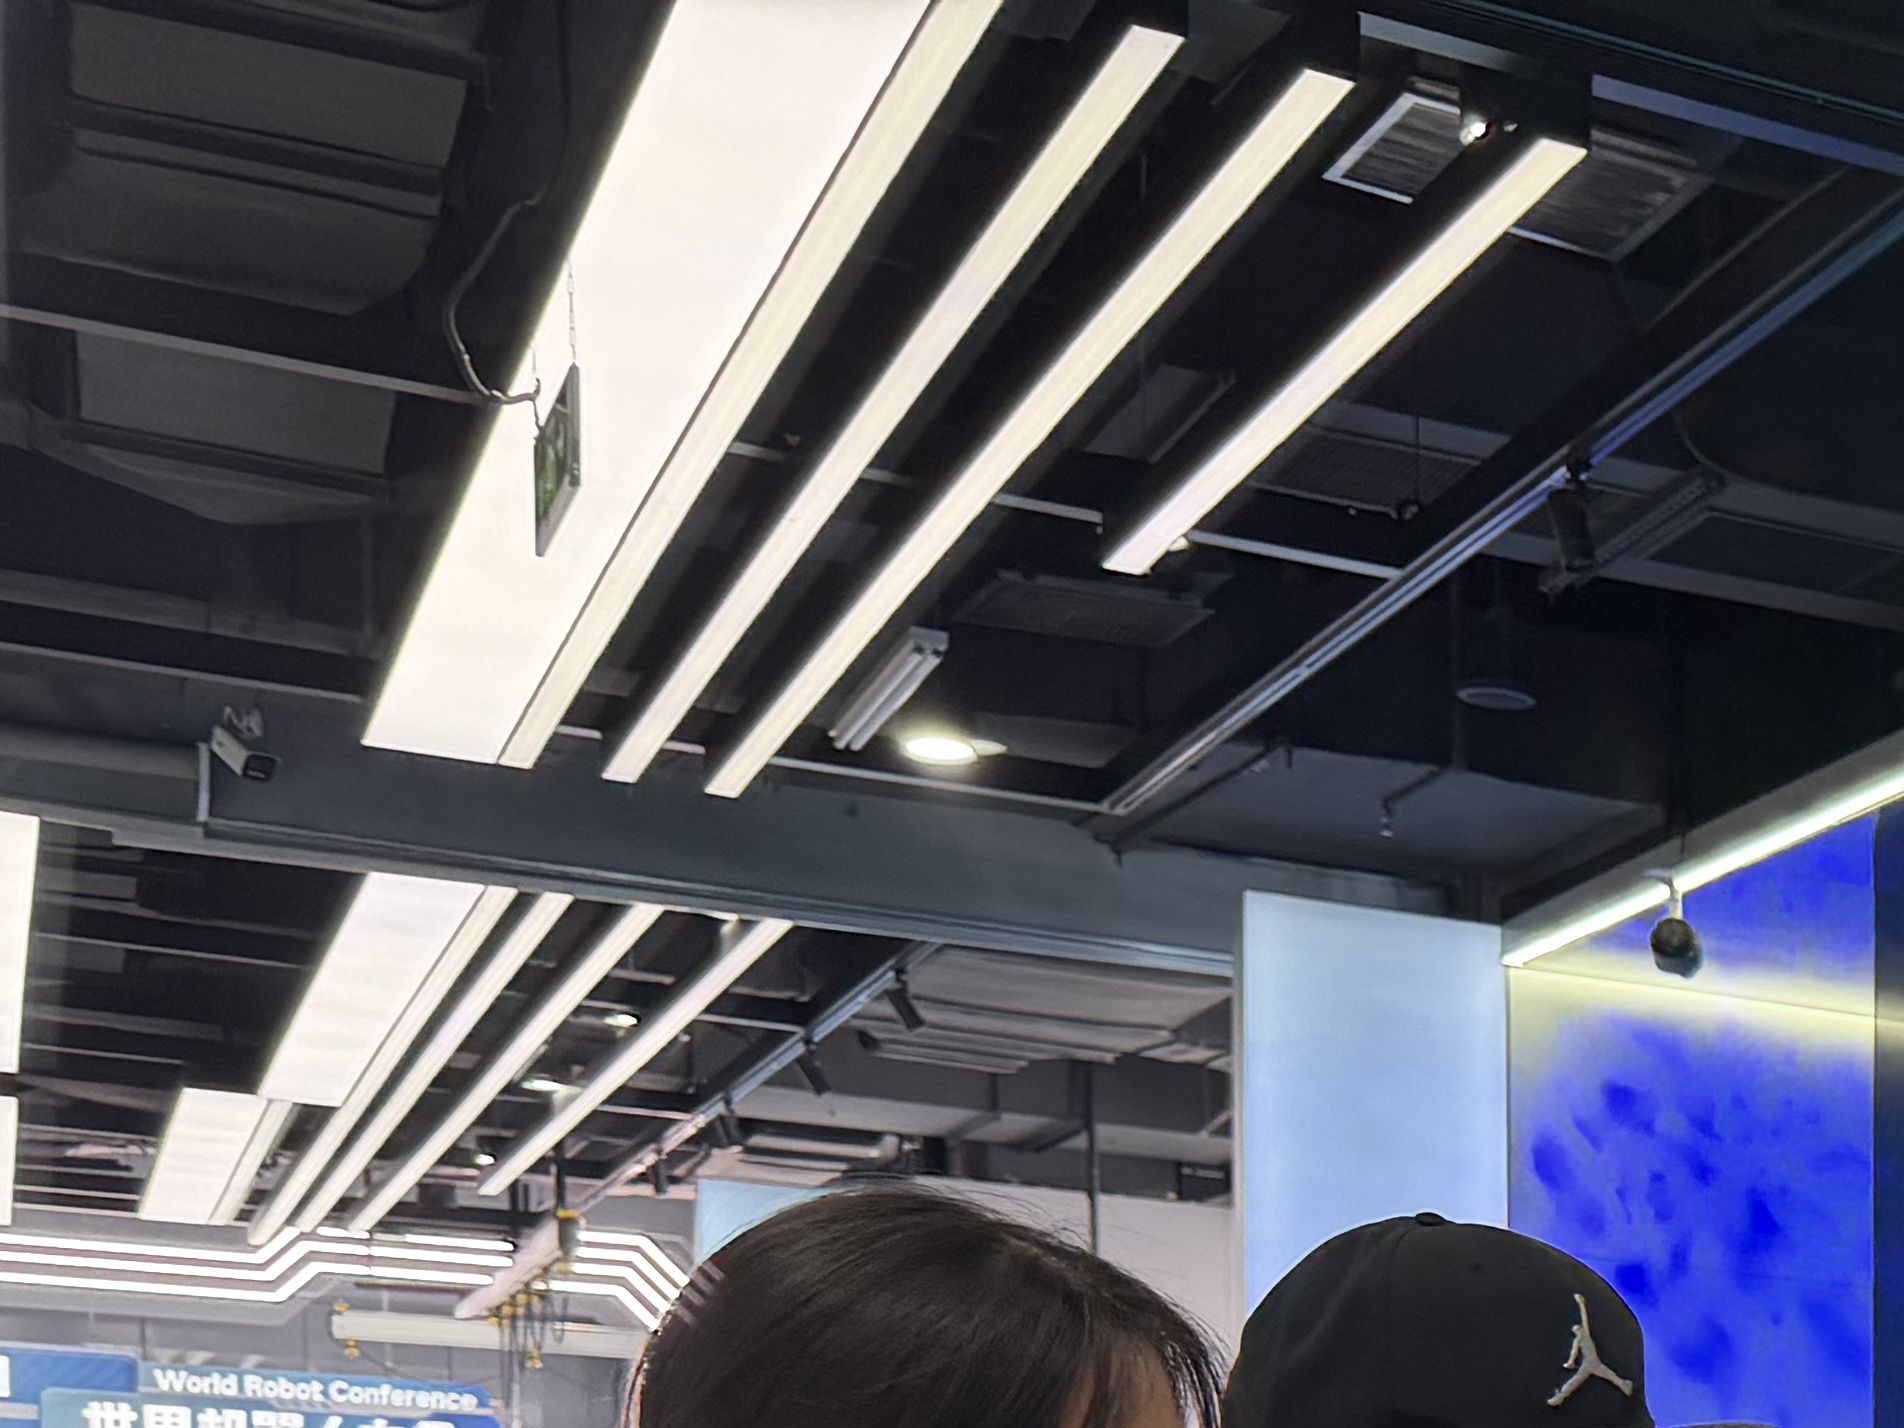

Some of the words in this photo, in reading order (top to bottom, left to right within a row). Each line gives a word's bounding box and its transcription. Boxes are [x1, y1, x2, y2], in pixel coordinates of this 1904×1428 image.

[153, 1368, 238, 1397] World
[243, 1376, 324, 1401] Robot
[328, 1380, 478, 1412] Conference
